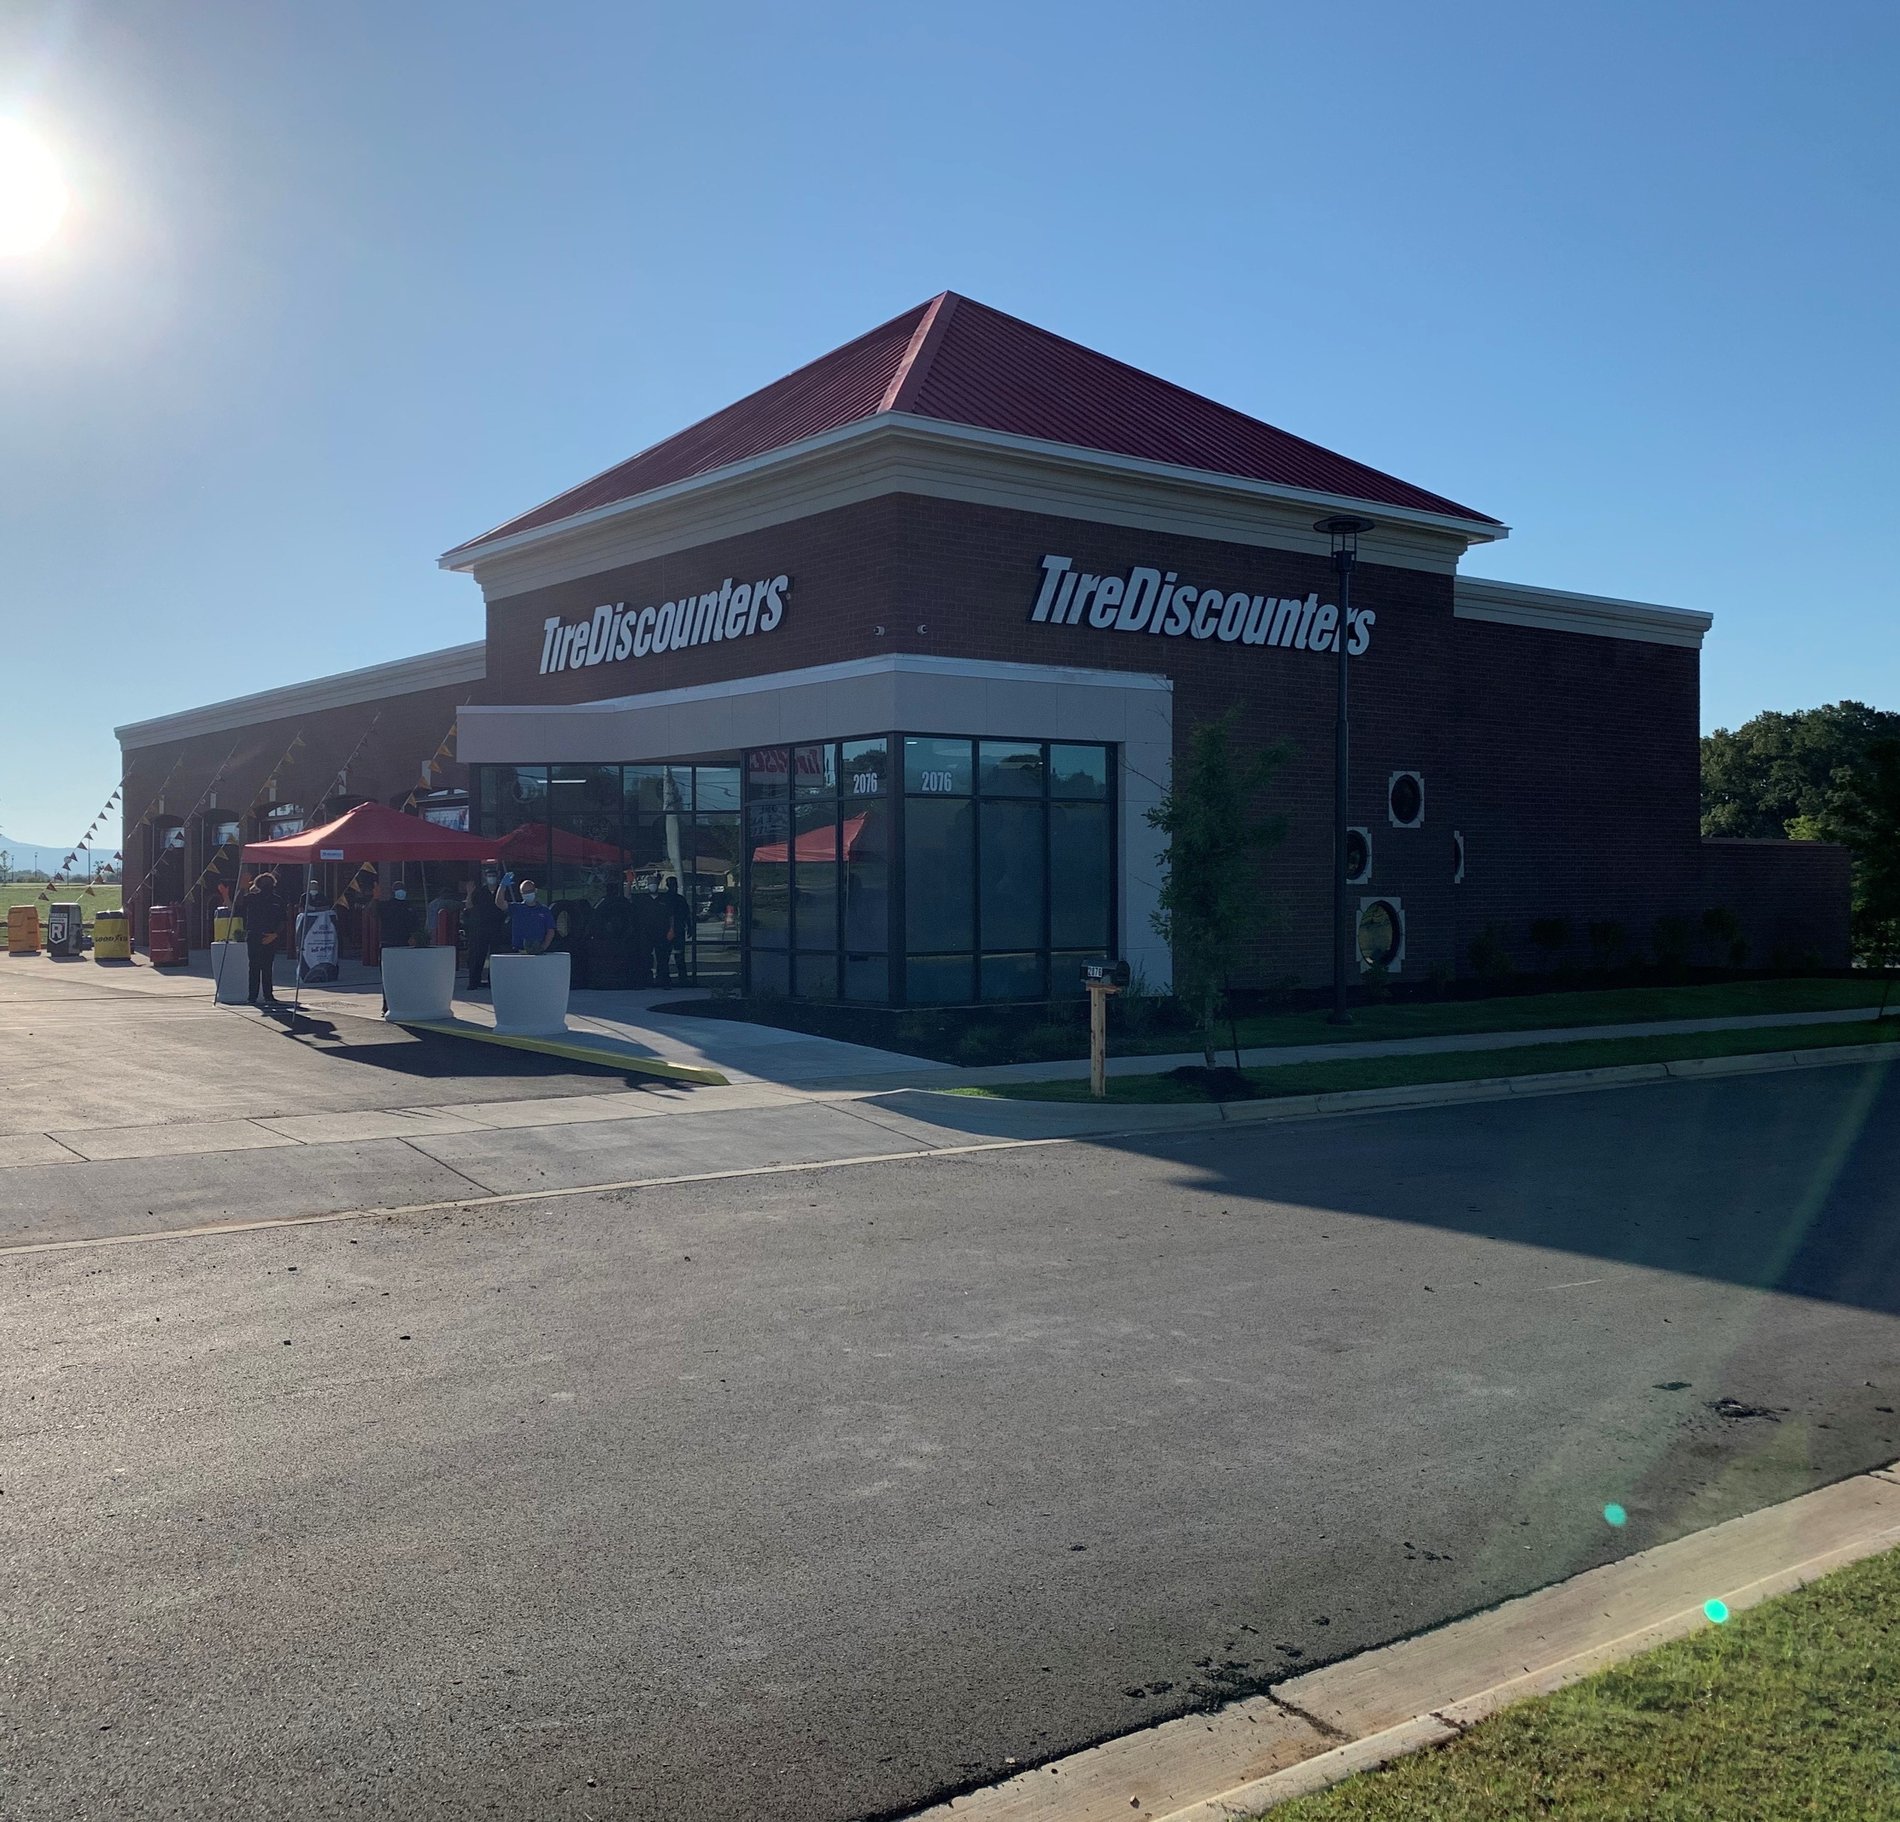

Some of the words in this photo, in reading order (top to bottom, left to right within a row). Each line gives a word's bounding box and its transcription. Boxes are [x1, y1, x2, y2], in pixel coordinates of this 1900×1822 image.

[539, 574, 789, 675] TireDiscounters
[853, 772, 878, 794] 2076
[921, 771, 952, 792] 2076
